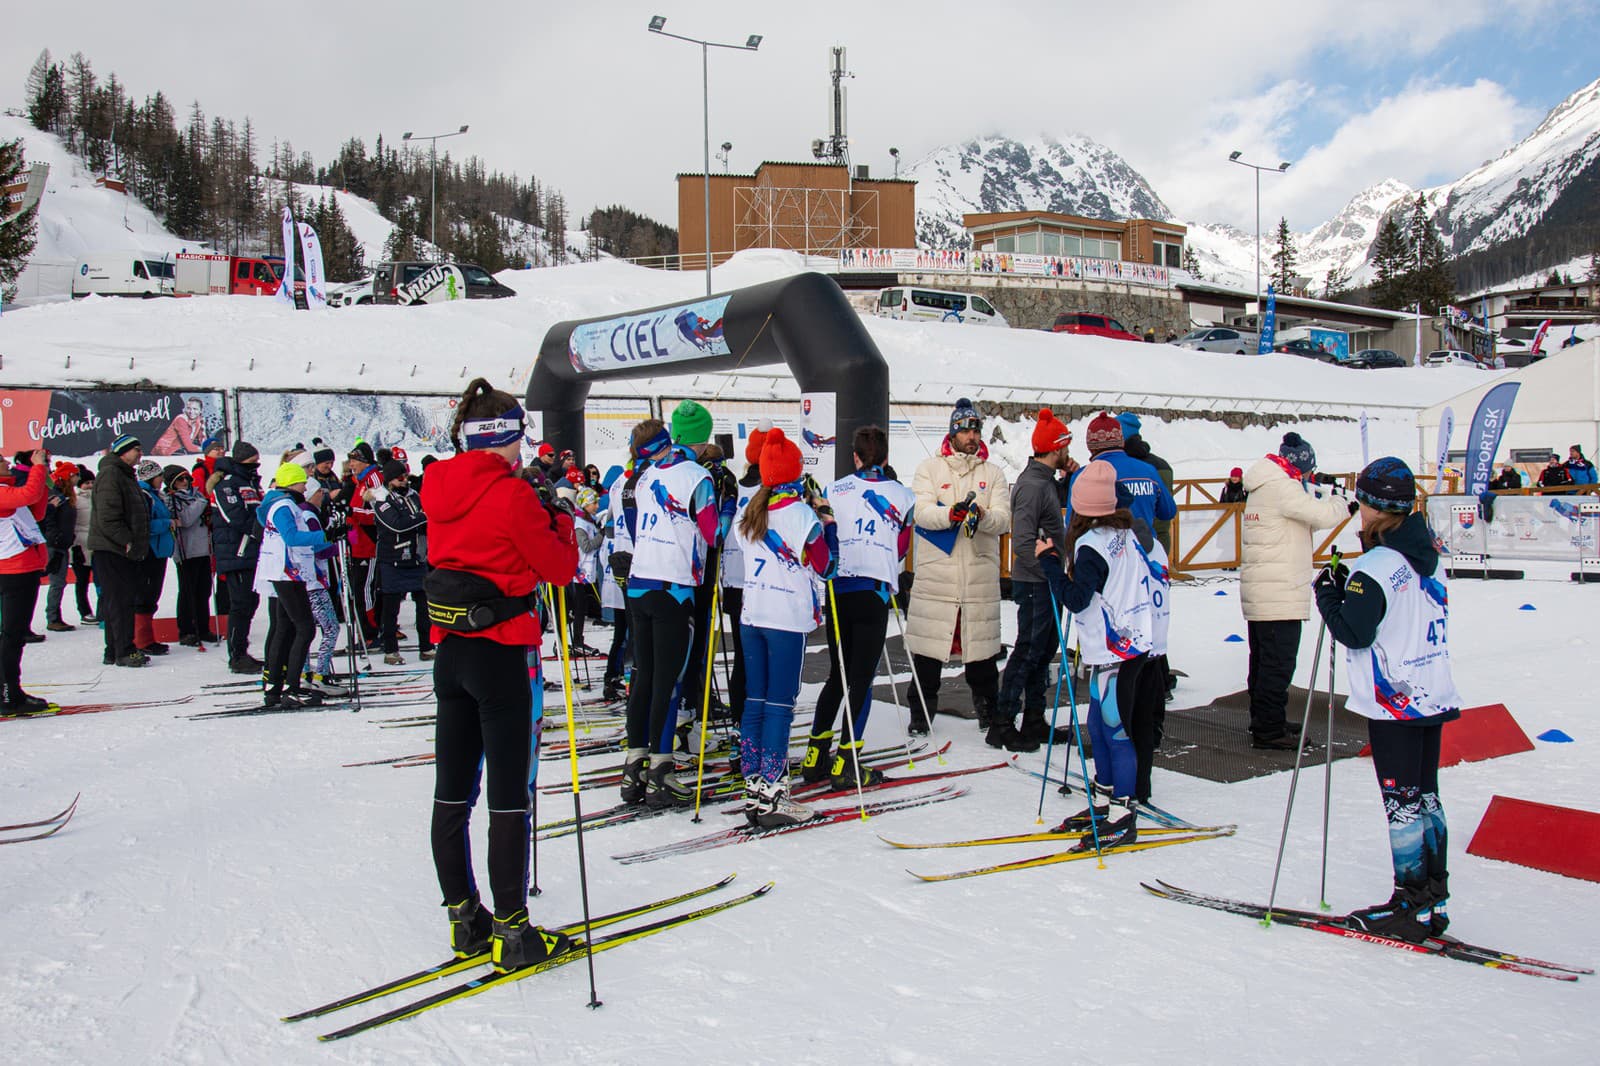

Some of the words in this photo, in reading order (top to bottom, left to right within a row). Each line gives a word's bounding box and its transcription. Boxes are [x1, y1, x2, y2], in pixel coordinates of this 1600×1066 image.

[28, 408, 103, 440] Celebrate
[107, 395, 170, 435] yourself
[1473, 407, 1500, 482] ŠPORT.SK
[1124, 481, 1154, 496] VAKIA
[641, 512, 658, 531] 19
[855, 517, 876, 536] 14
[754, 557, 767, 577] 7
[1426, 618, 1447, 646] 47
